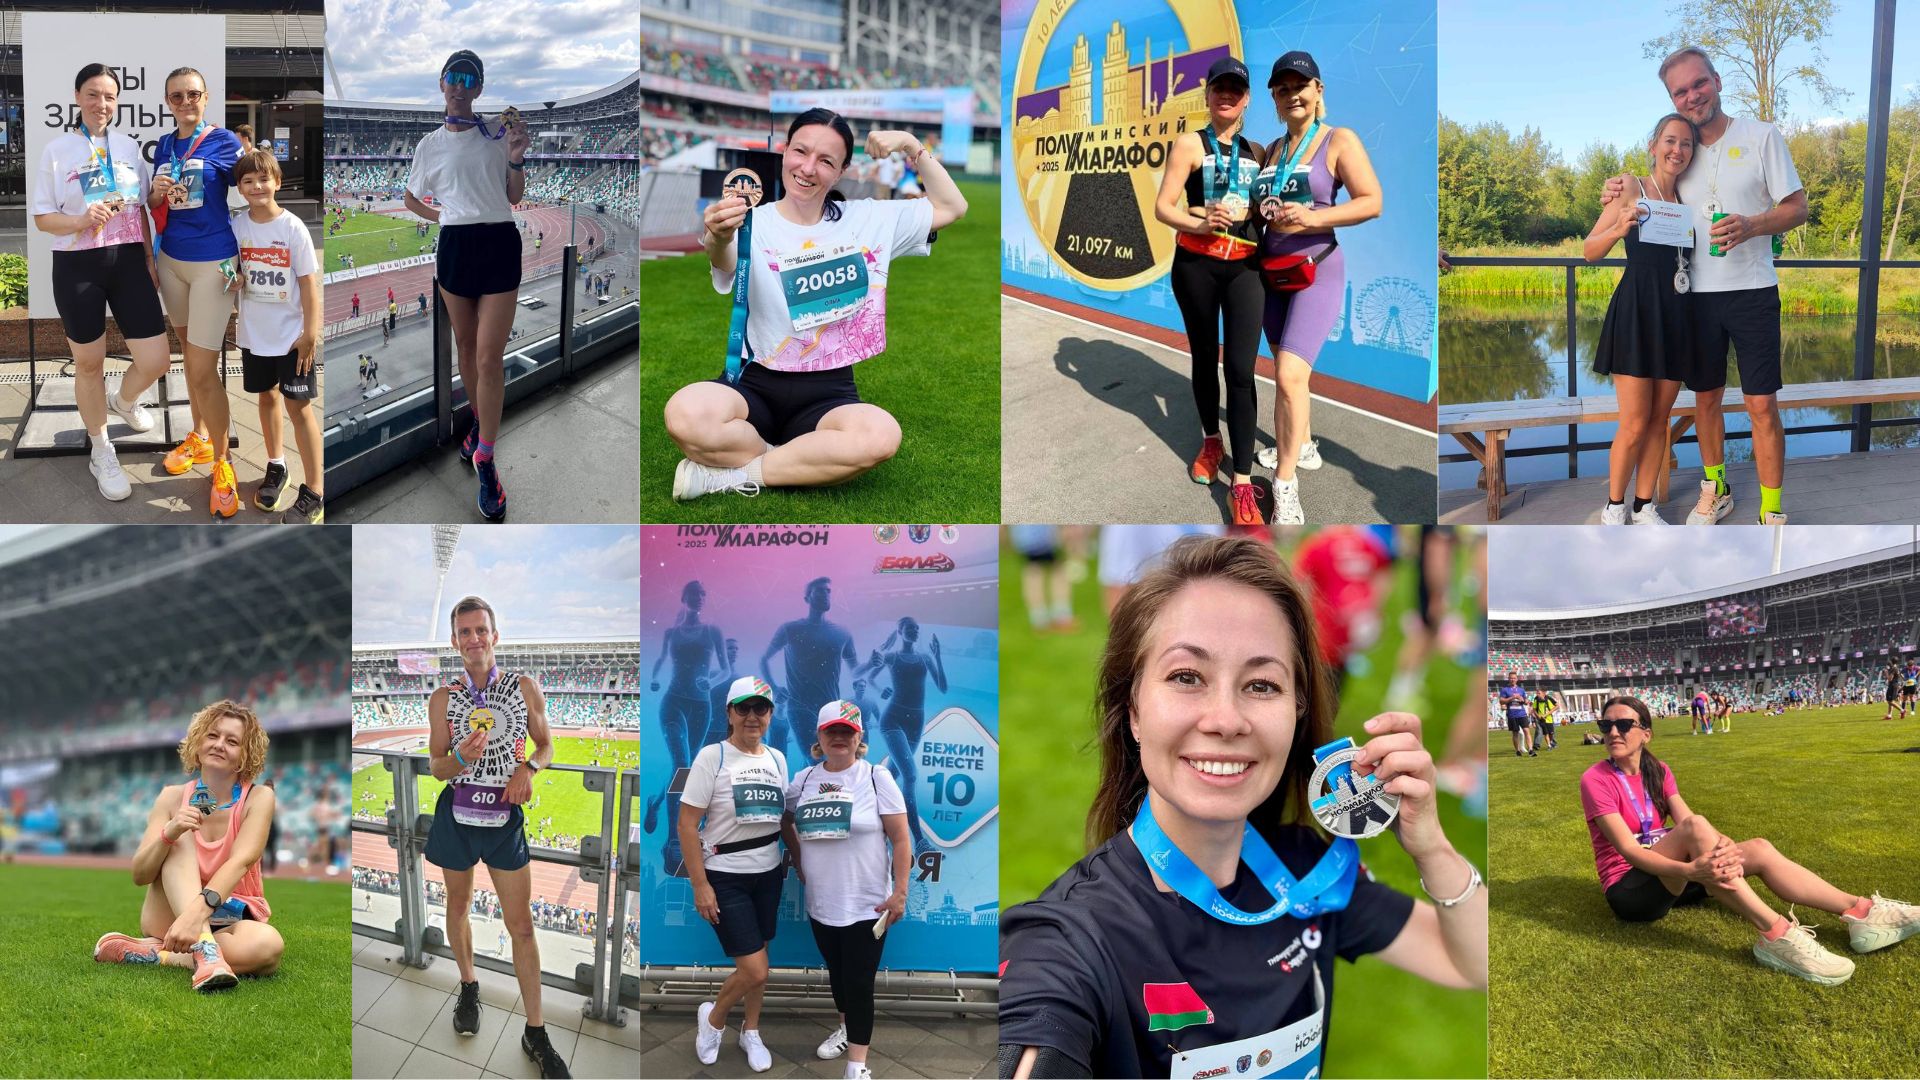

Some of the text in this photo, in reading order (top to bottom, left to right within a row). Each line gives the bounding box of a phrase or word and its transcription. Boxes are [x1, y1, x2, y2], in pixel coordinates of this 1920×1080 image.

[1037, 23, 1049, 44] 10
[44, 103, 177, 132] ЗДЛЬН
[1085, 116, 1187, 142] МИНСКИЙ
[1035, 132, 1083, 156] ПОЛУ
[1042, 162, 1059, 171] 2025
[1215, 173, 1253, 185] 2136
[1259, 179, 1298, 196] 2162
[1067, 234, 1112, 256] 21,097
[250, 271, 286, 286] 7816
[795, 264, 858, 295] 20058
[684, 540, 707, 548] 2025
[715, 531, 829, 547] МАРАФОН
[923, 741, 984, 757] БЕЖИМ
[922, 755, 984, 770] ВМЕСТЕ
[744, 789, 779, 801] 21592
[927, 772, 975, 806] 10
[471, 792, 496, 804] 610
[802, 806, 842, 819] 21596
[932, 809, 963, 822] ЛЕТ
